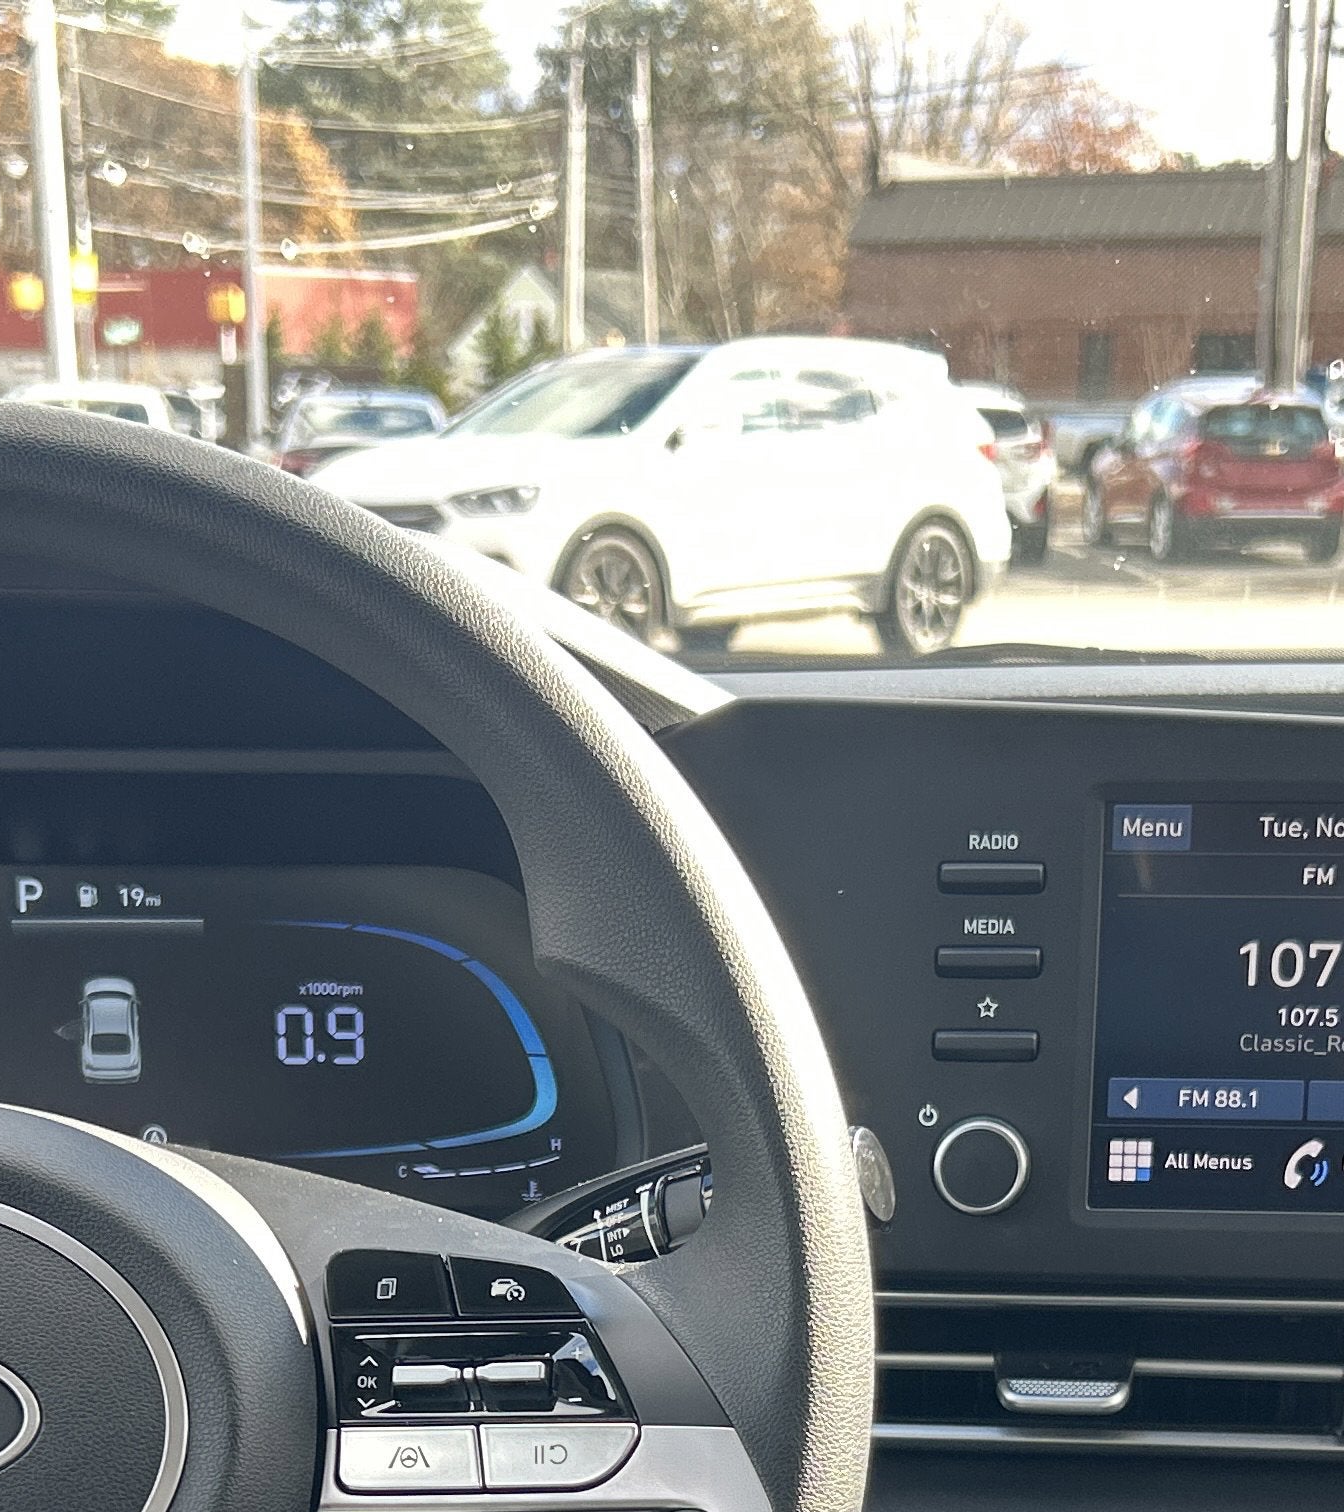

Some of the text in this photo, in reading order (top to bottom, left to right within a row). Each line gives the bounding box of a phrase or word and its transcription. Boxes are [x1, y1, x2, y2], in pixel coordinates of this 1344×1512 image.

[1122, 817, 1183, 838] Menu
[1259, 816, 1309, 840] Tue,
[969, 833, 1019, 850] RADIO
[1302, 866, 1335, 886] FM
[18, 878, 44, 911] P
[963, 918, 1015, 935] MEDIA
[299, 982, 364, 998] x1000rpm
[1278, 1007, 1339, 1028] 107.5
[276, 1006, 365, 1065] 0.9
[1178, 1089, 1257, 1108] FM 88.1
[1164, 1153, 1253, 1170] All Menus
[605, 1198, 630, 1215] MIST
[606, 1228, 623, 1243] INT
[609, 1244, 624, 1257] LO
[357, 1375, 378, 1389] OK
